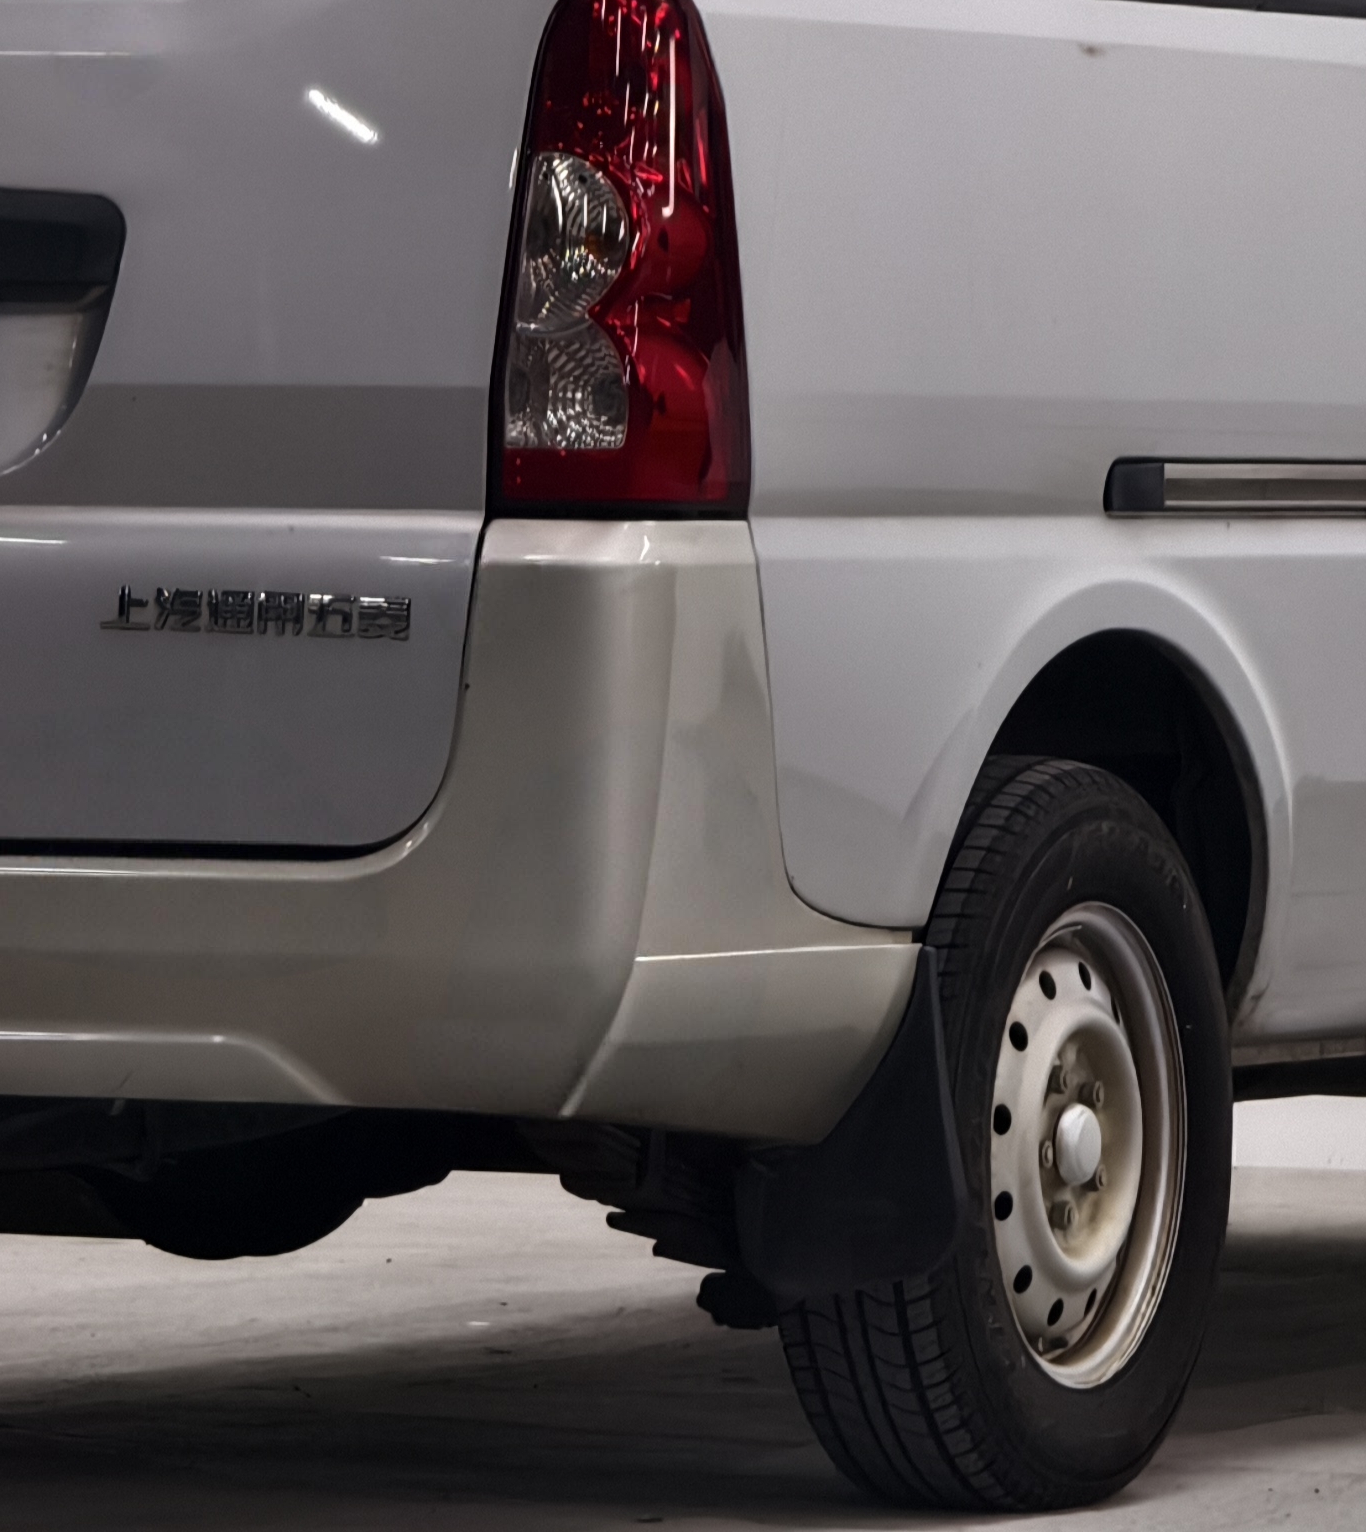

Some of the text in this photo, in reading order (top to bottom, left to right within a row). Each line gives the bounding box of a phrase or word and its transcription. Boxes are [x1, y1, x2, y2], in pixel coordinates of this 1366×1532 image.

[99, 584, 412, 642] 上汽通用五菱
